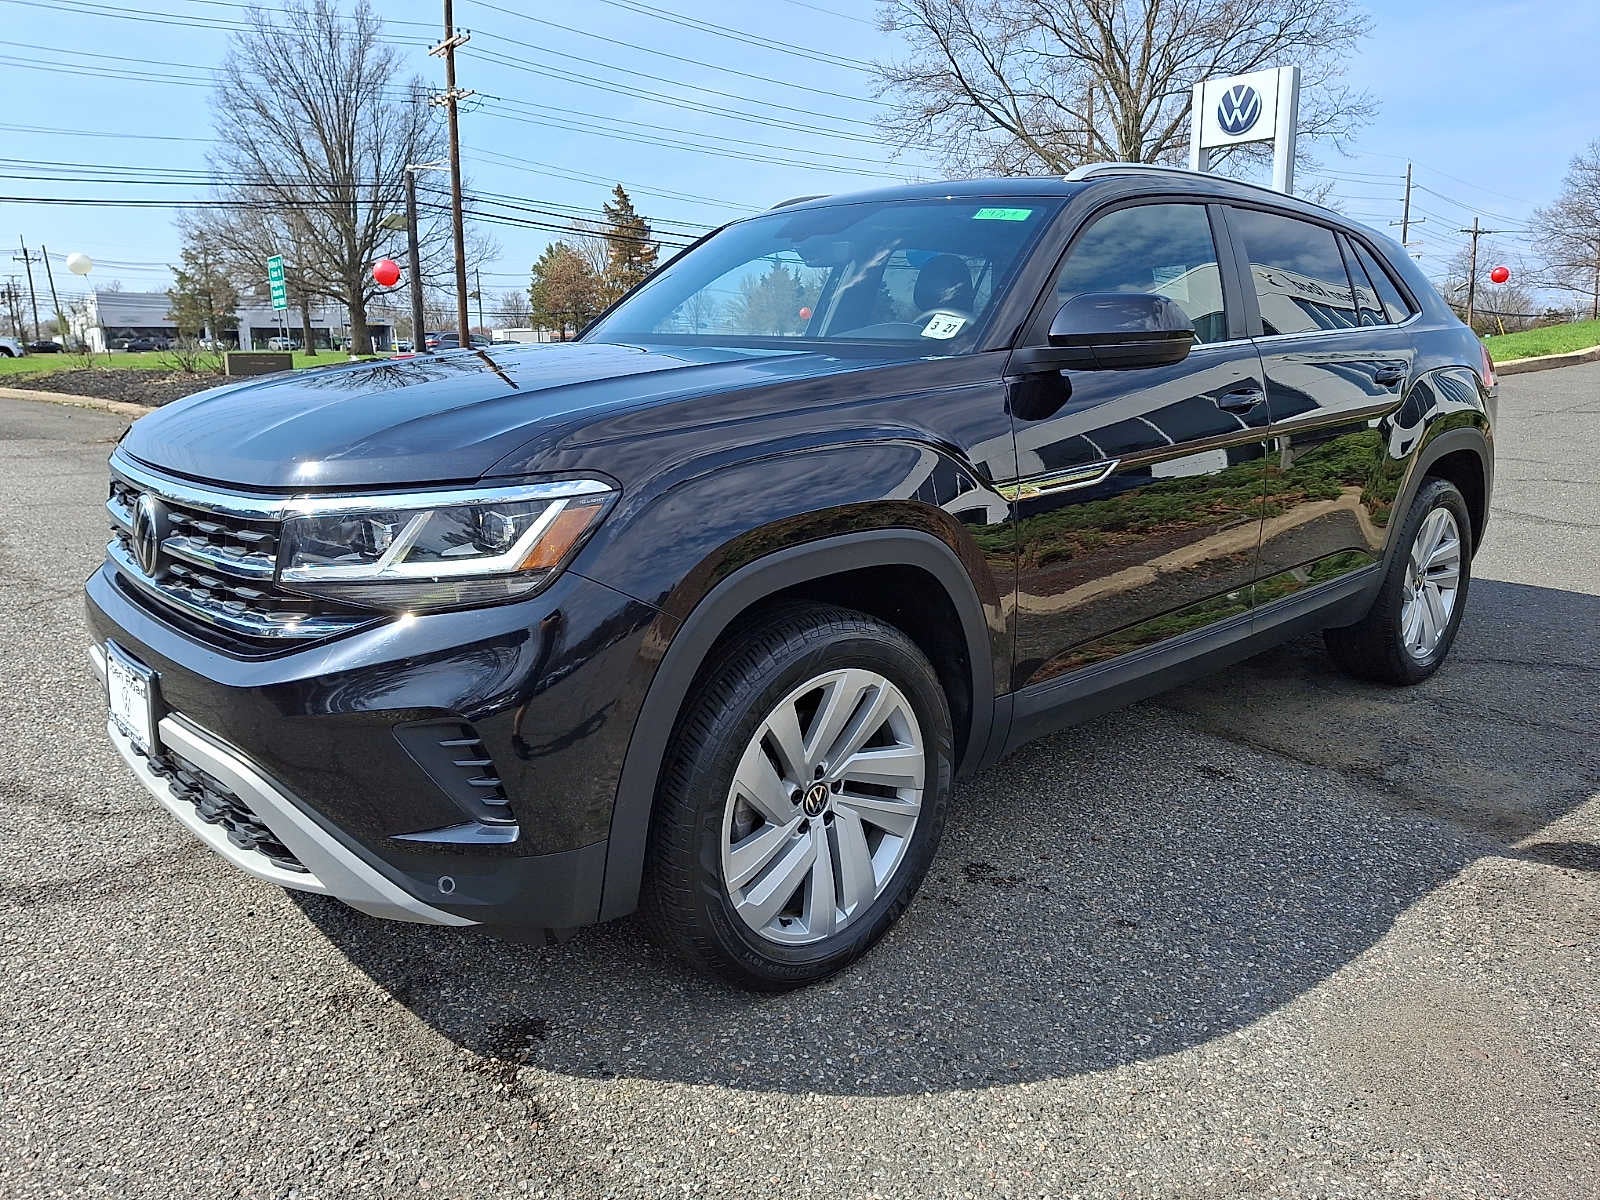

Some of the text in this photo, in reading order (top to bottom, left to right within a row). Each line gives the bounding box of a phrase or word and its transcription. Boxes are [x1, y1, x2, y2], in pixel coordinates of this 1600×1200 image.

[1218, 84, 1262, 136] VW
[930, 321, 958, 334] 3 27
